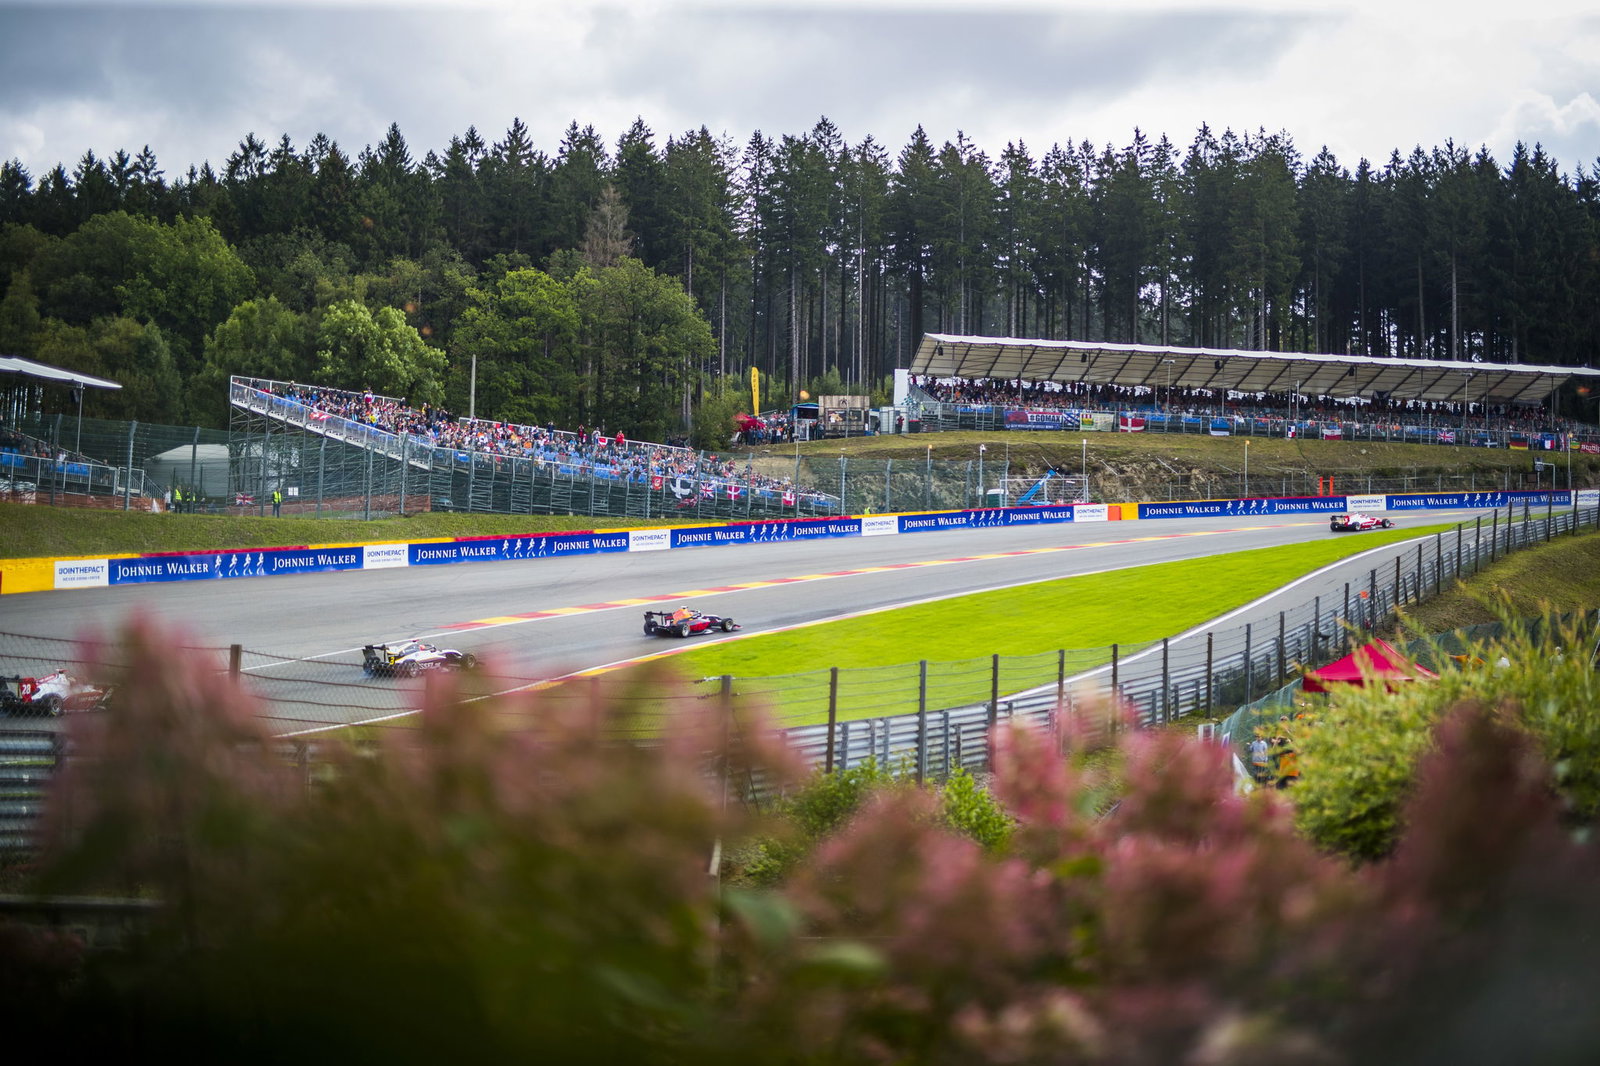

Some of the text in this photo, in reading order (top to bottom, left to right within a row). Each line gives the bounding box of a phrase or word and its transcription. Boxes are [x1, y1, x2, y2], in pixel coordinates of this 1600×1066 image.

[1275, 503, 1309, 512] JOHNNIE
[1393, 499, 1425, 507] JOHNNIE
[1009, 511, 1071, 523] JOHNNIE WALKER
[1146, 506, 1221, 516] JOHNNIE WALKER
[793, 524, 859, 538] JOHNNIE WALKER
[904, 517, 967, 531] JOHNNIE WALKER
[677, 531, 745, 545] JOHNNIE WALKER
[553, 538, 627, 554] JOHNNIE WALKER
[416, 546, 497, 561] JOHNNIE WALKER
[273, 554, 356, 571] JOHNNIE WALKER
[117, 562, 209, 581] JOHNNIE WALKER
[22, 684, 31, 695] 28
